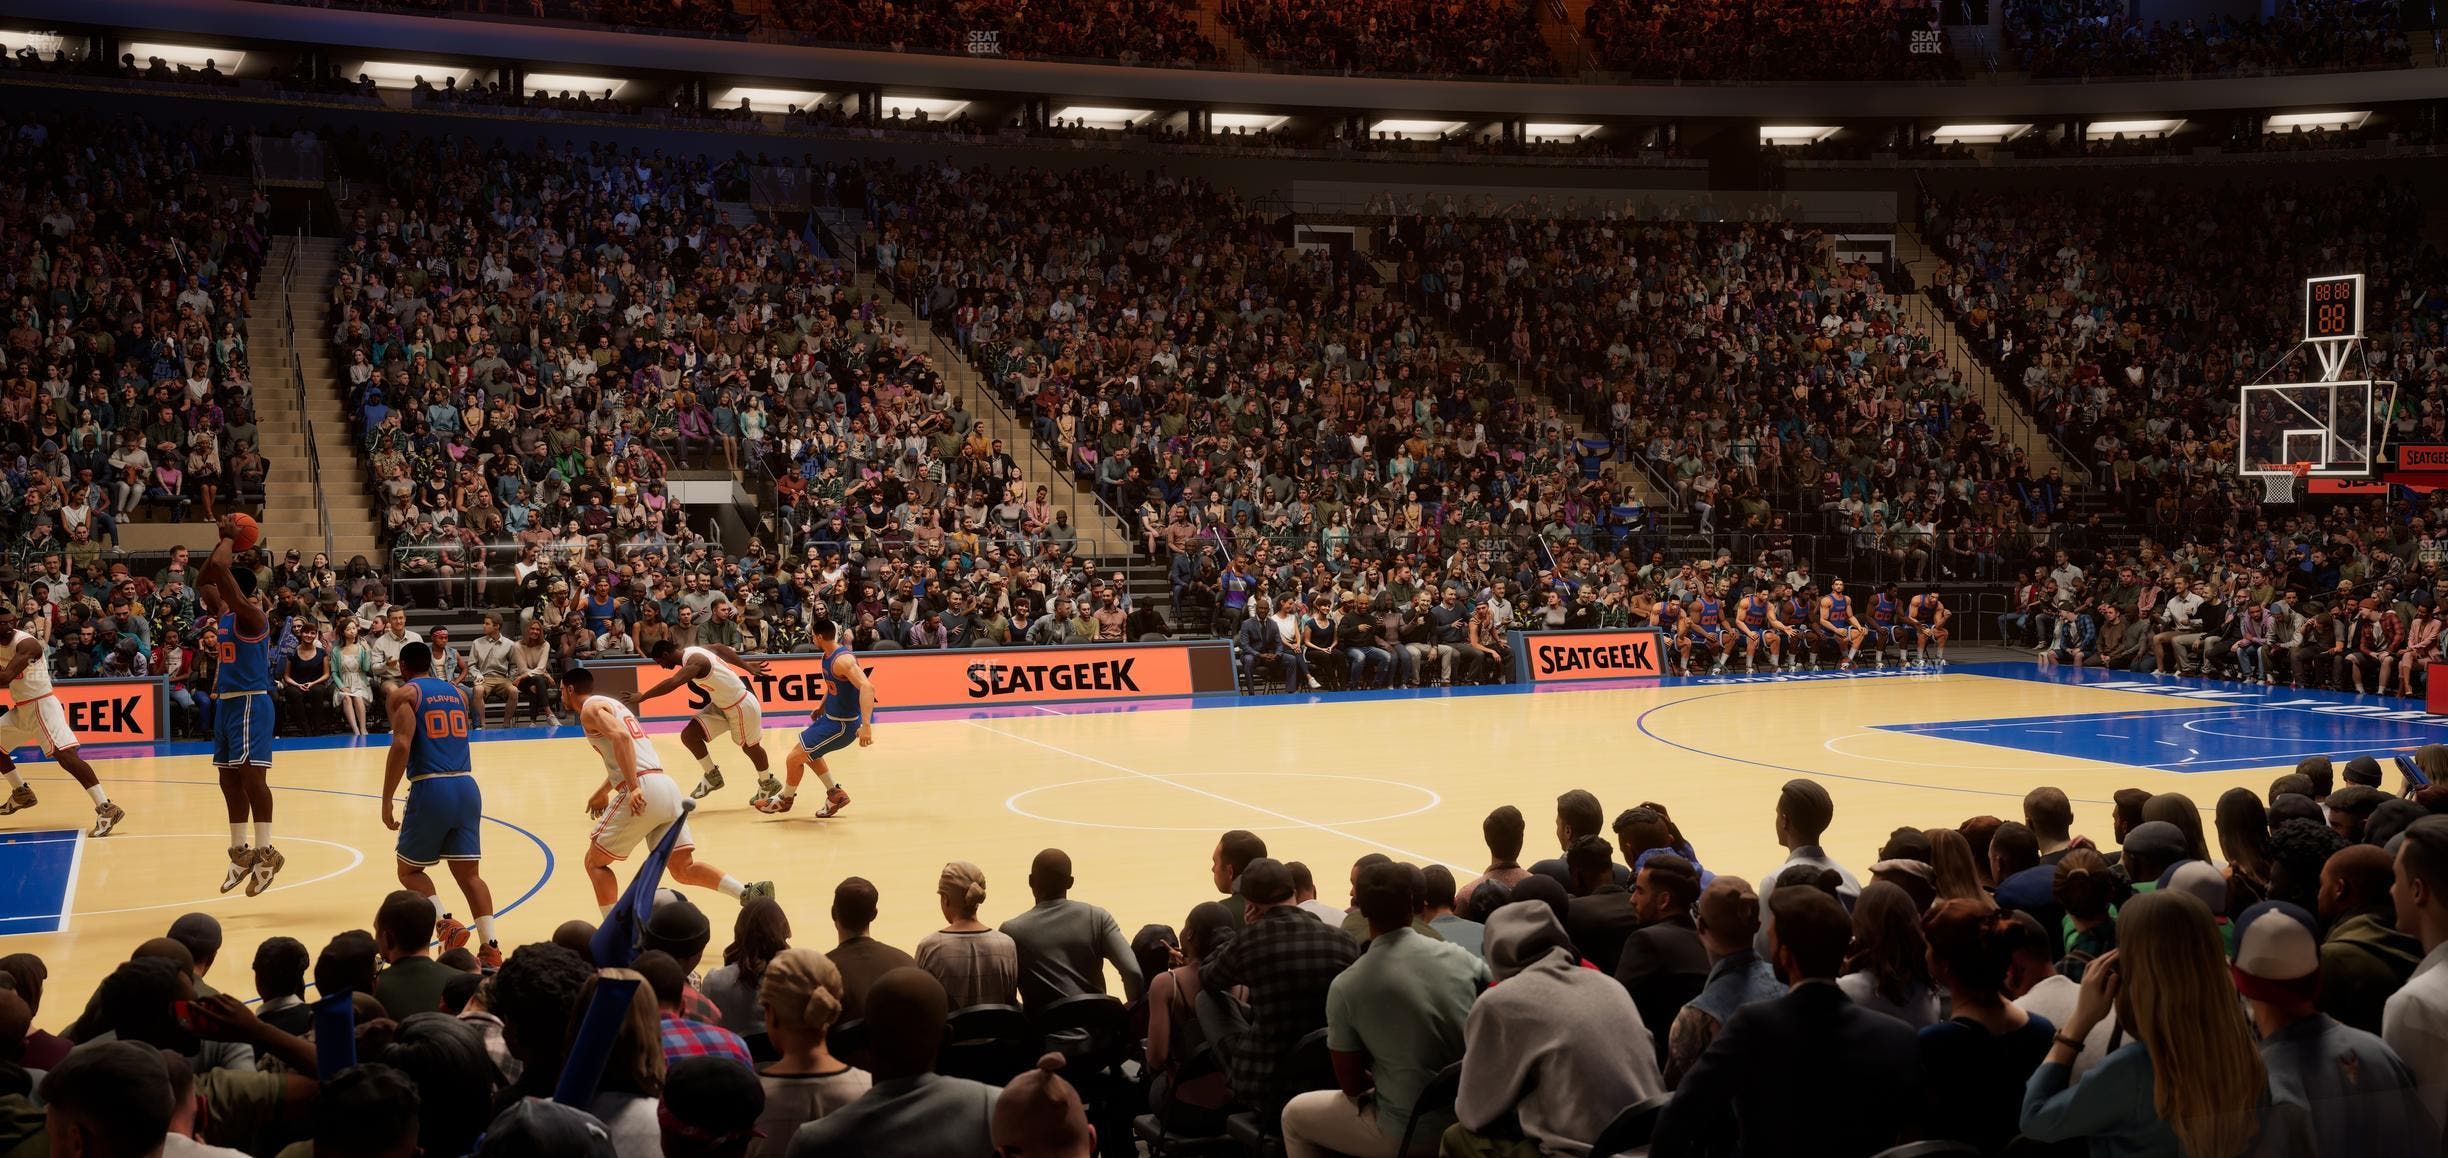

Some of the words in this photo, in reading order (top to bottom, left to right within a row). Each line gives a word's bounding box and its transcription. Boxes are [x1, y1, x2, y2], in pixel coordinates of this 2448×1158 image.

[2319, 304, 2345, 333] 88
[1539, 641, 1654, 674] SEATGEEK
[967, 658, 1140, 698] SEATGEEK
[427, 694, 460, 705] PLAYER
[425, 710, 467, 739] 00
